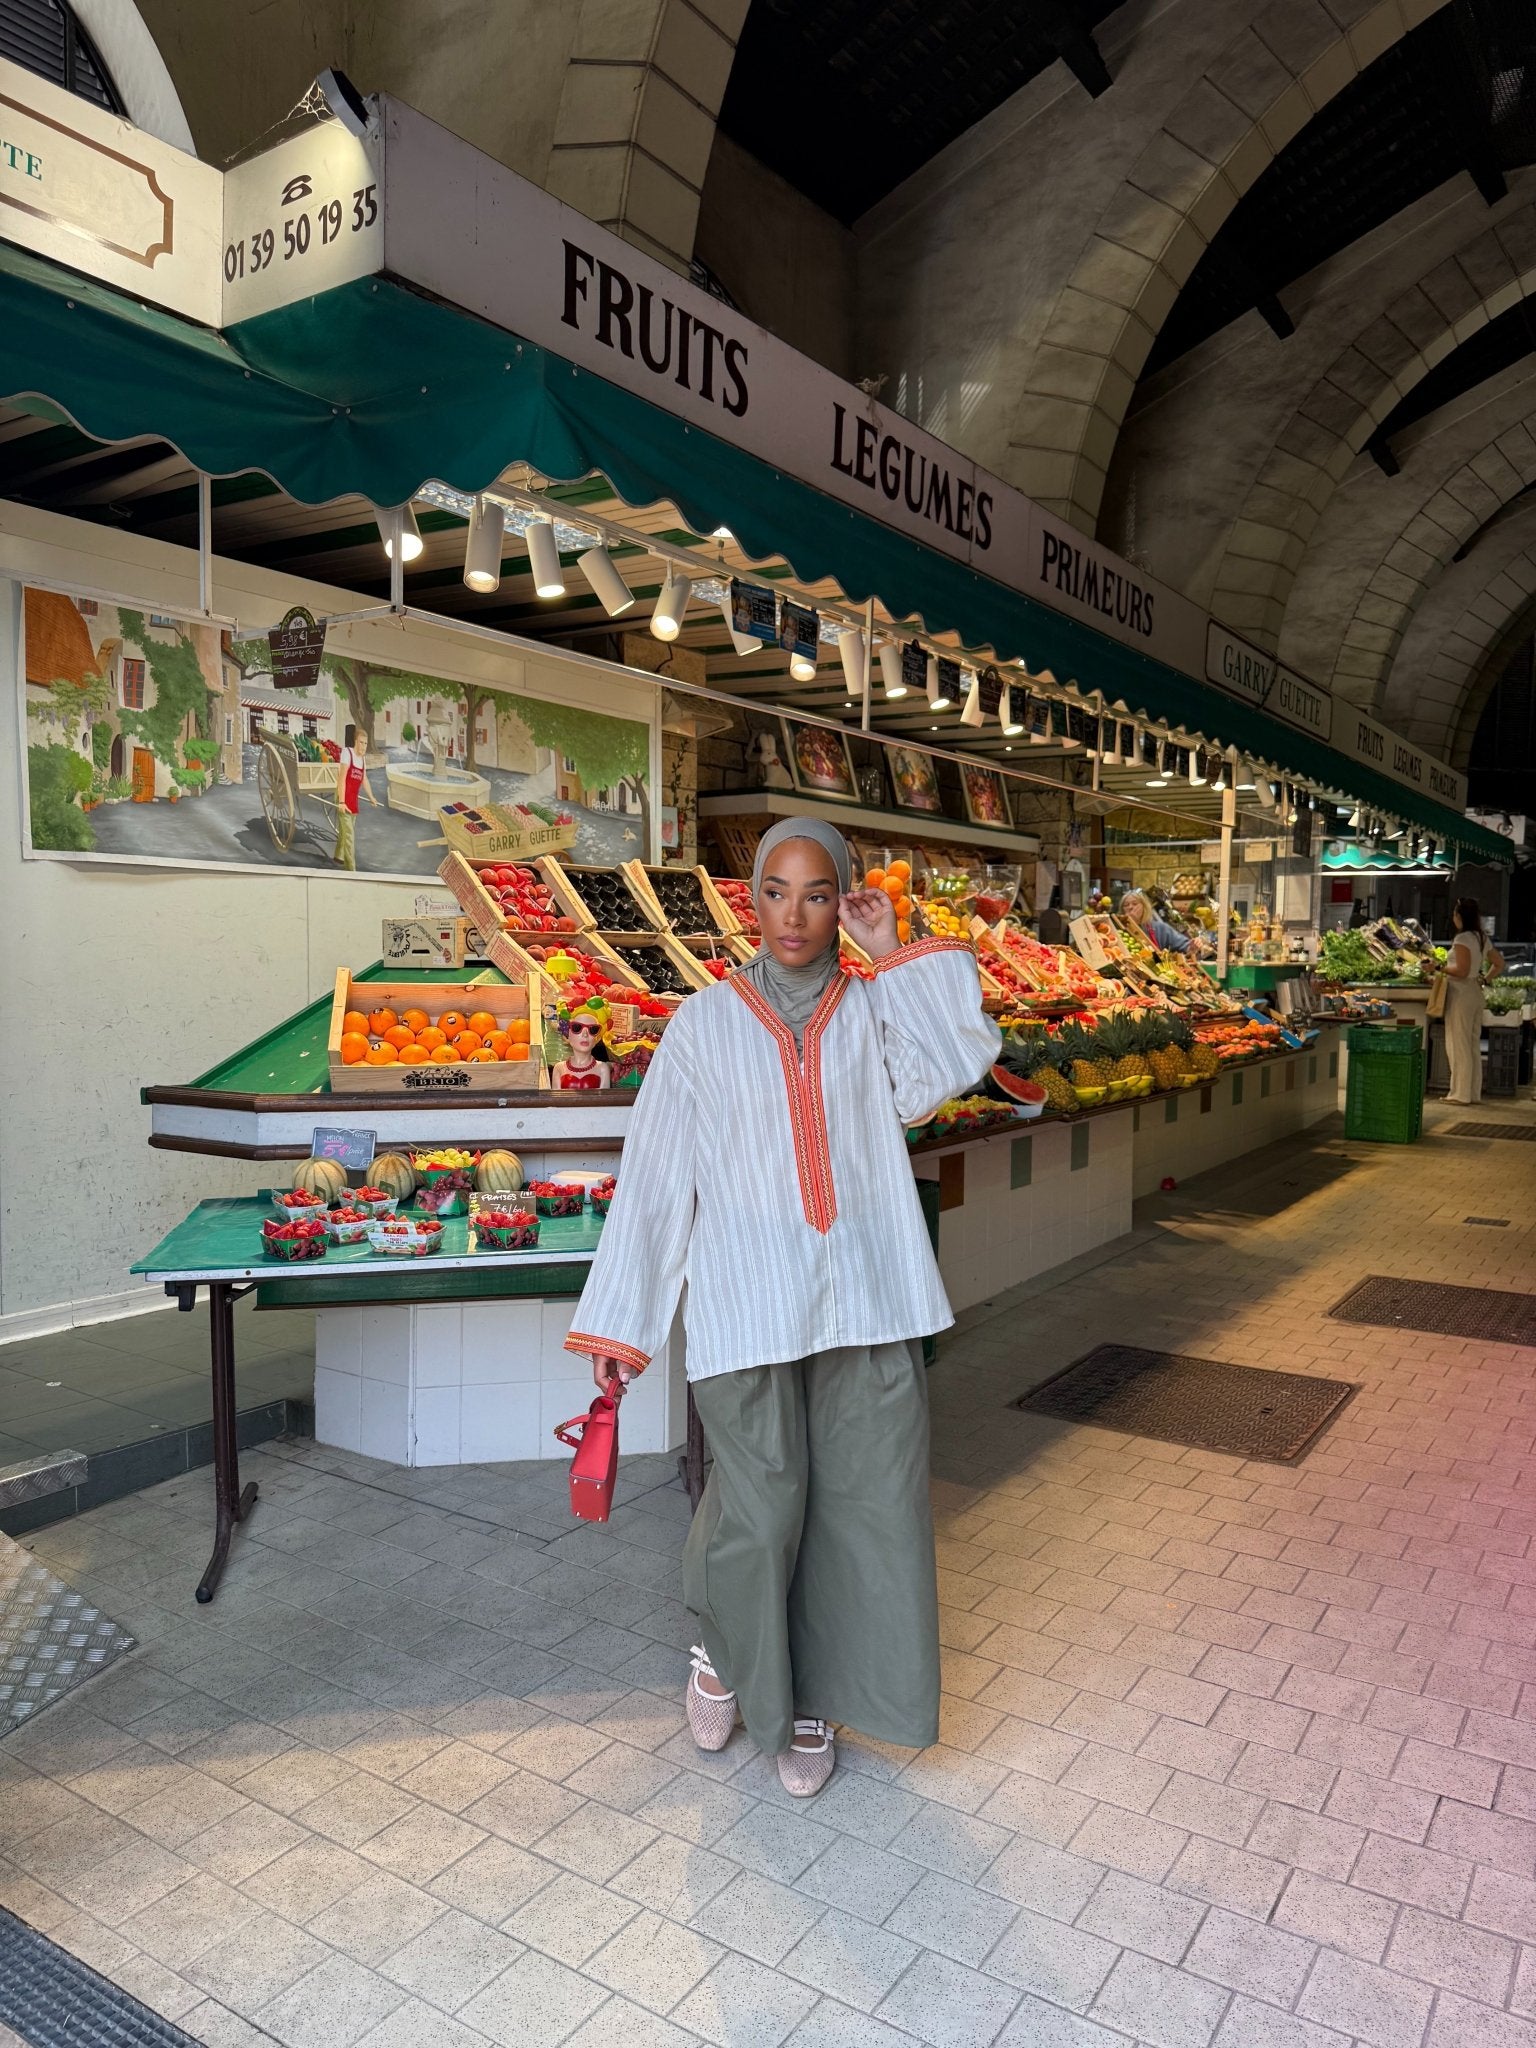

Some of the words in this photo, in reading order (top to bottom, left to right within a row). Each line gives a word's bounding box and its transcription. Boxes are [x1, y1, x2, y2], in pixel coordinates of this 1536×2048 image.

[0, 140, 42, 181] TE
[224, 239, 245, 283] 01
[250, 228, 275, 273] 39
[284, 213, 311, 261] 50
[317, 199, 343, 245] 19
[351, 184, 378, 232] 35
[560, 239, 749, 418] FRUITS
[830, 402, 993, 551] LEGUMES
[1040, 530, 1154, 637] PRIMEURS
[1223, 644, 1270, 697] GARRY
[1279, 678, 1322, 727] GUETTE
[1357, 722, 1384, 763] FRUITS
[489, 834, 521, 853] GARRY
[529, 828, 561, 846] GUETTE
[420, 1078, 456, 1086] BRIO
[481, 1193, 517, 1202] FRAISES
